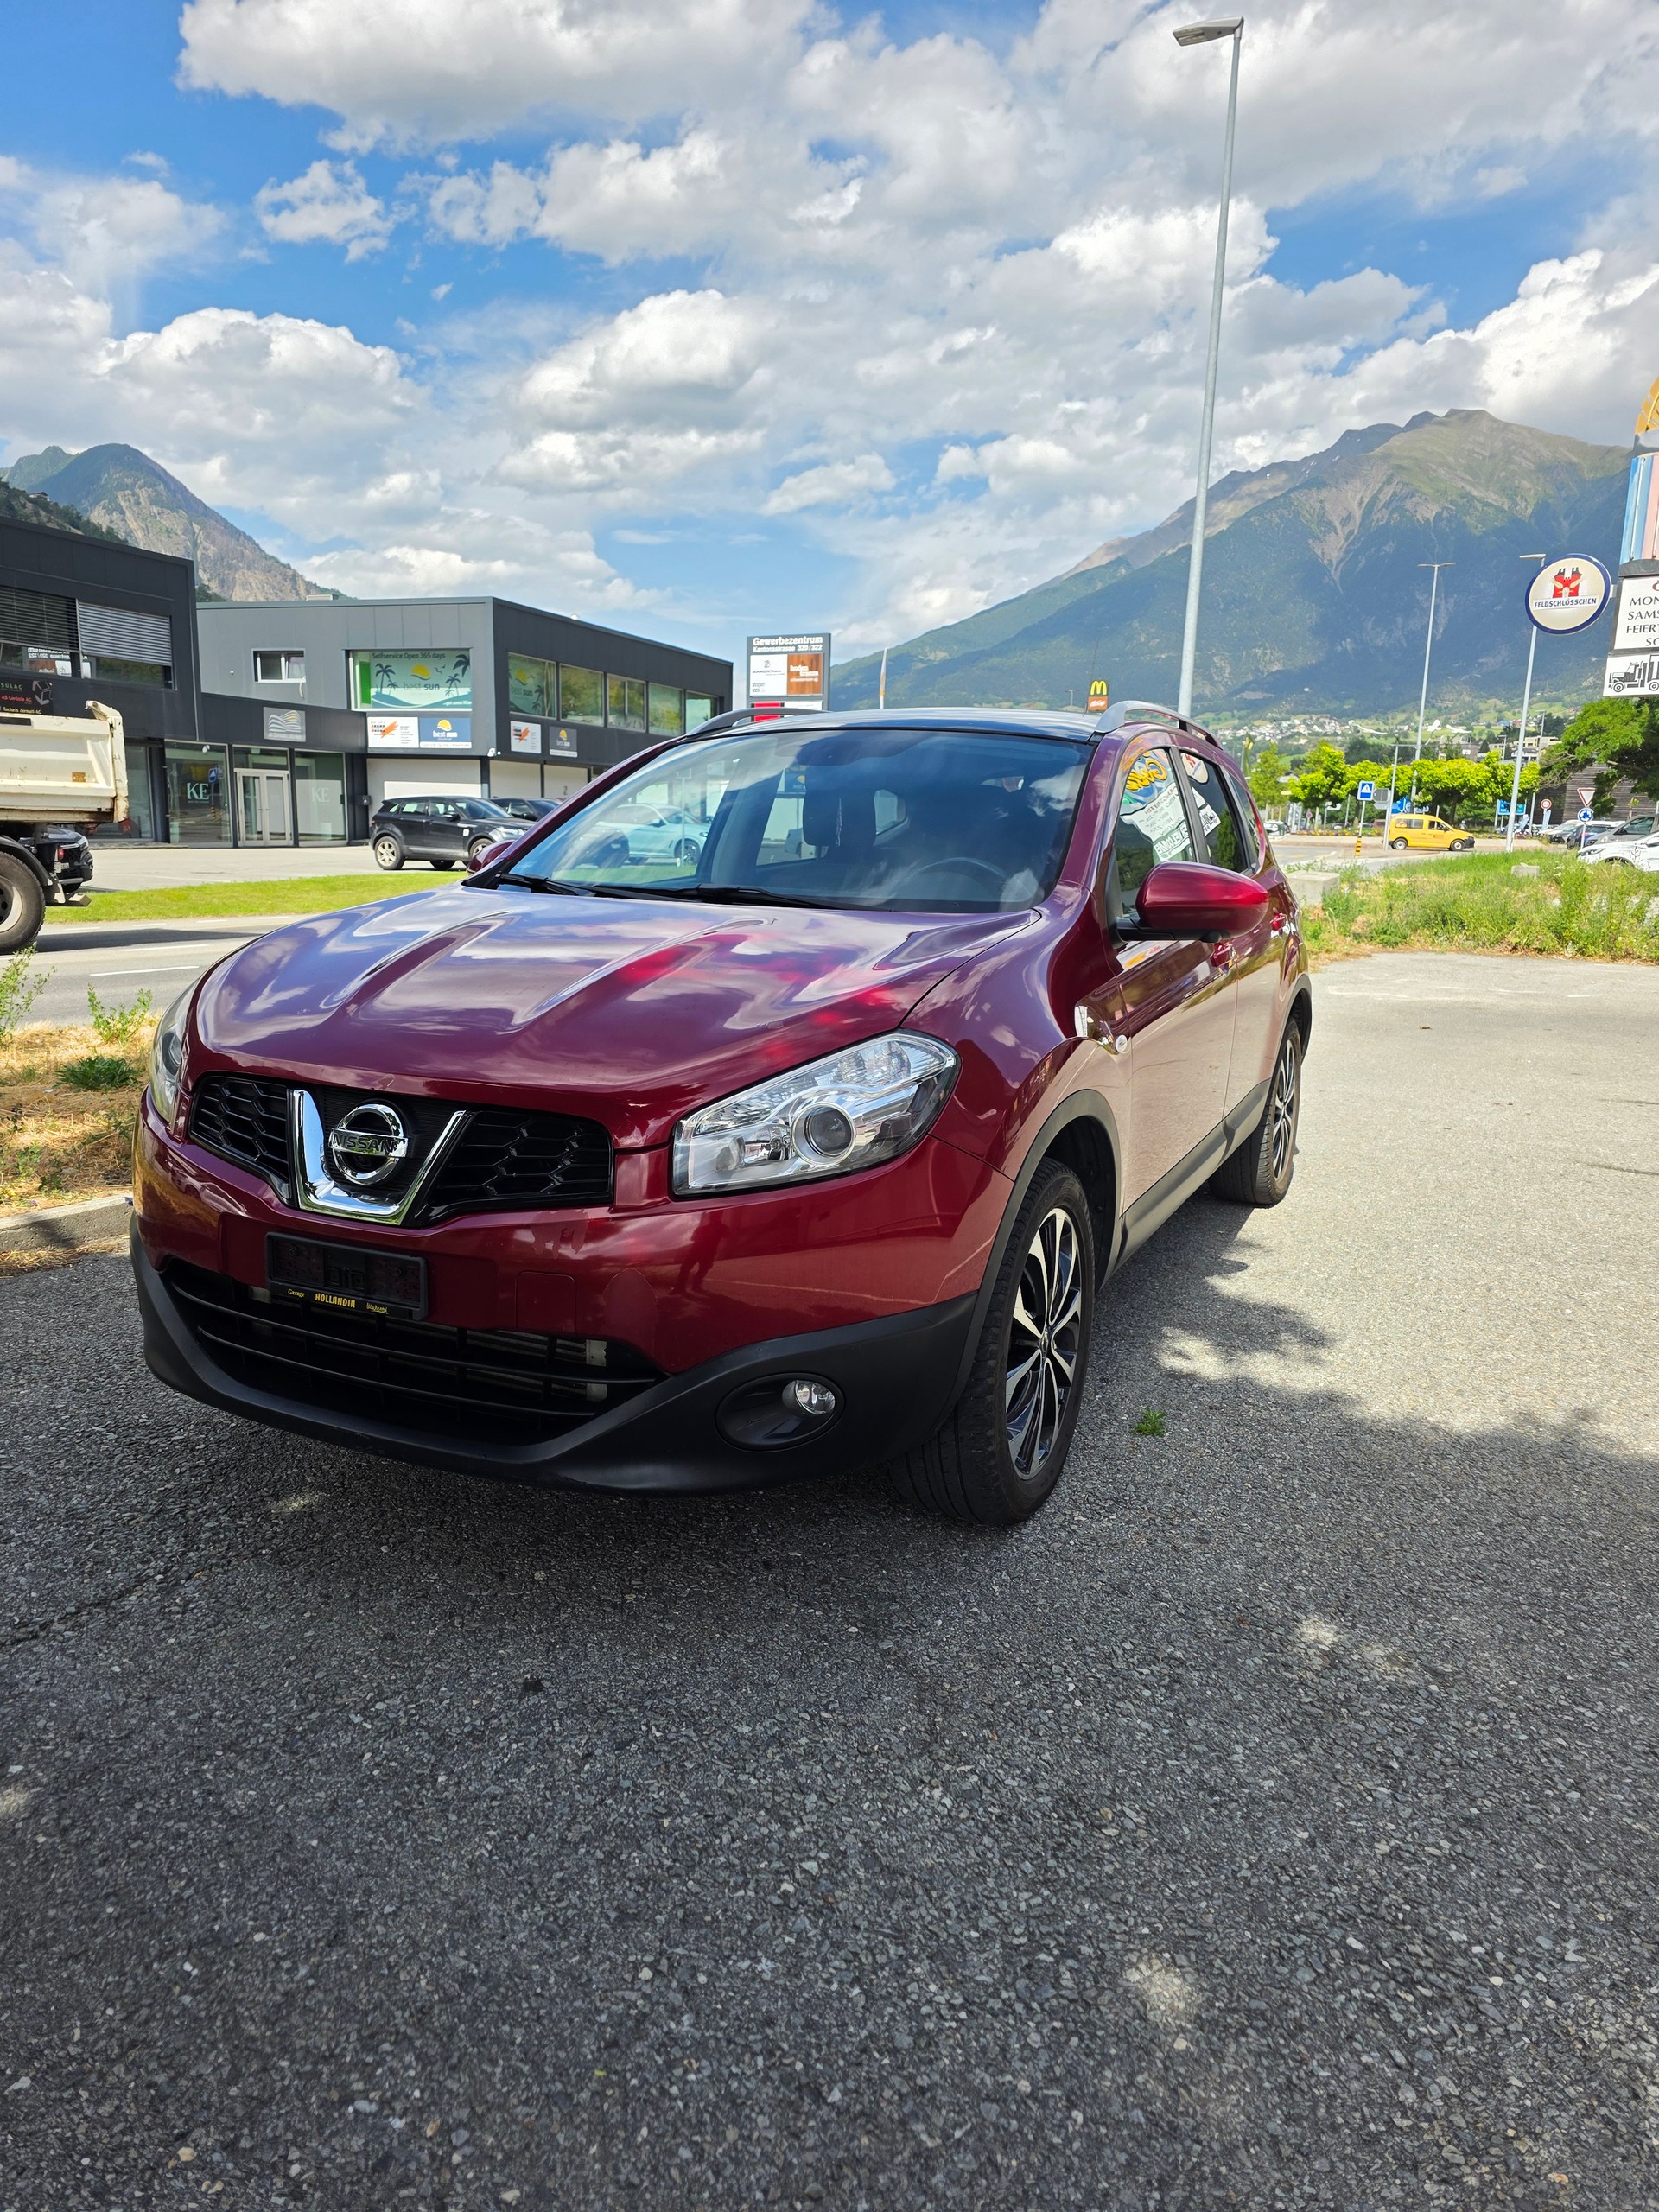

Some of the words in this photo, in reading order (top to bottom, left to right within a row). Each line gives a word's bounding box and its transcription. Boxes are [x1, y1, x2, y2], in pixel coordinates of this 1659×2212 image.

[1534, 597, 1597, 608] FELDSCHLÖSSCHEN
[753, 636, 823, 646] Gewerbezentrum
[187, 782, 209, 800] KE
[311, 787, 330, 803] KE
[331, 1133, 398, 1153] NISSAN
[287, 1288, 305, 1299] Garage
[315, 1293, 355, 1308] HOLLANDIA
